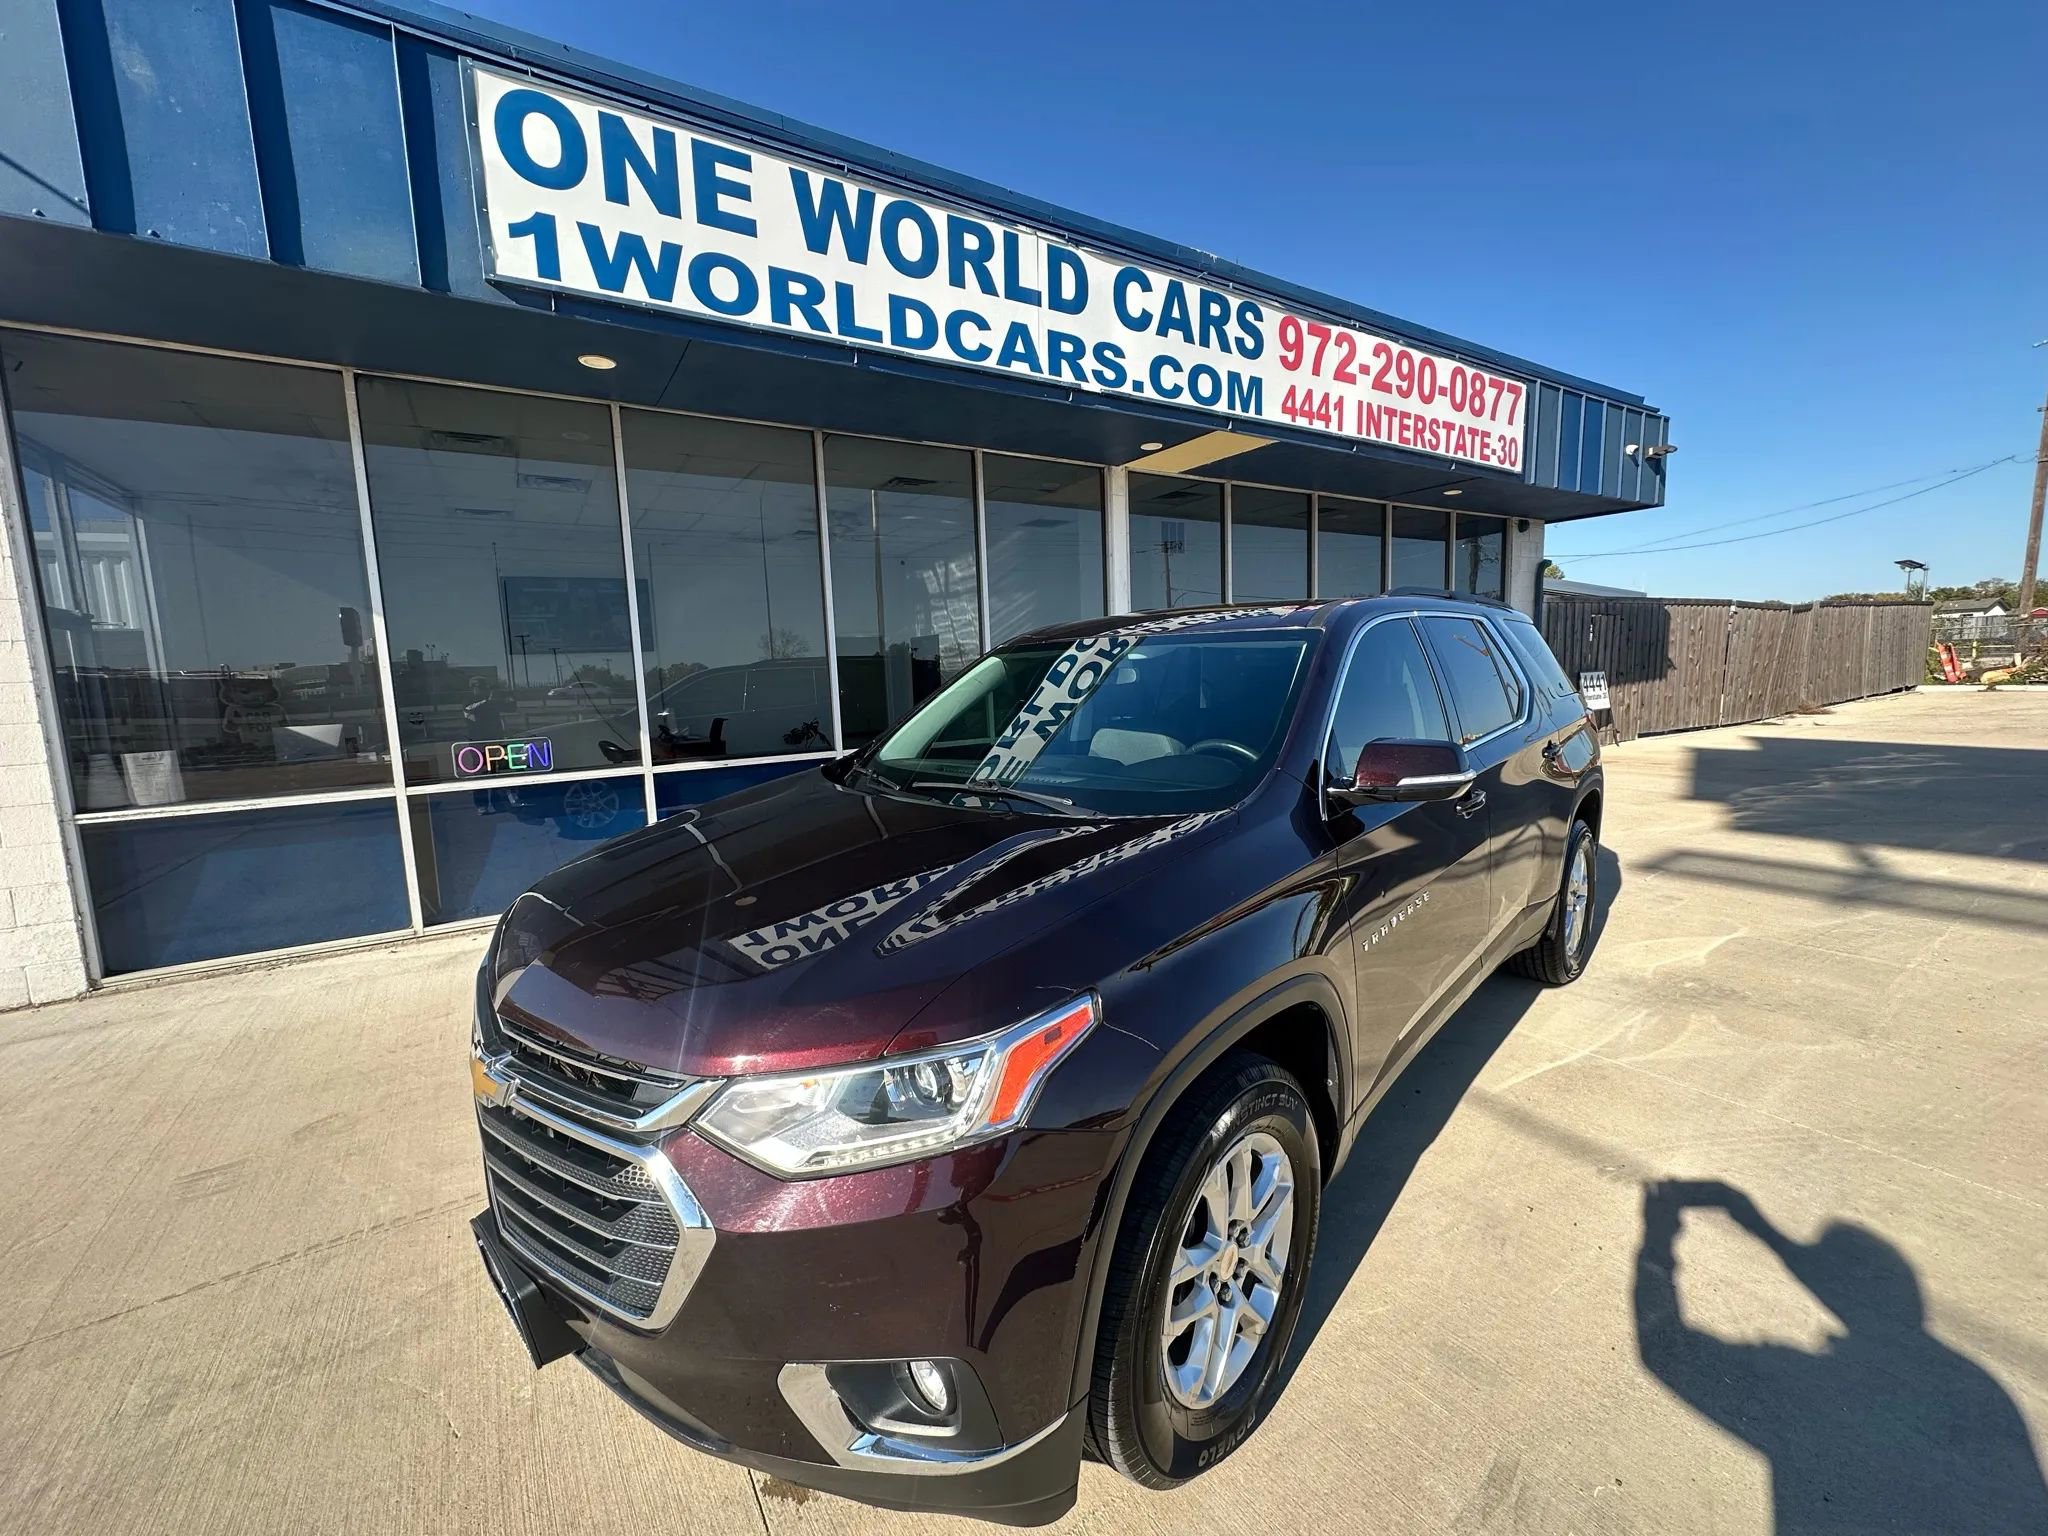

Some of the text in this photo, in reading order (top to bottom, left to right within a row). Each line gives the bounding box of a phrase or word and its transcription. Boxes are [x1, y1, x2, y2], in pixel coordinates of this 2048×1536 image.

[494, 89, 1264, 361] ONE WORLD CARS
[509, 212, 1263, 416] 1WORLDCARS.COM
[1278, 315, 1522, 426] 972-290-0877
[1281, 385, 1519, 468] 4441 INTERSTATE-30
[1583, 673, 1607, 692] 4441
[458, 742, 549, 773] OPEN
[1361, 891, 1430, 952] TRAVERSE
